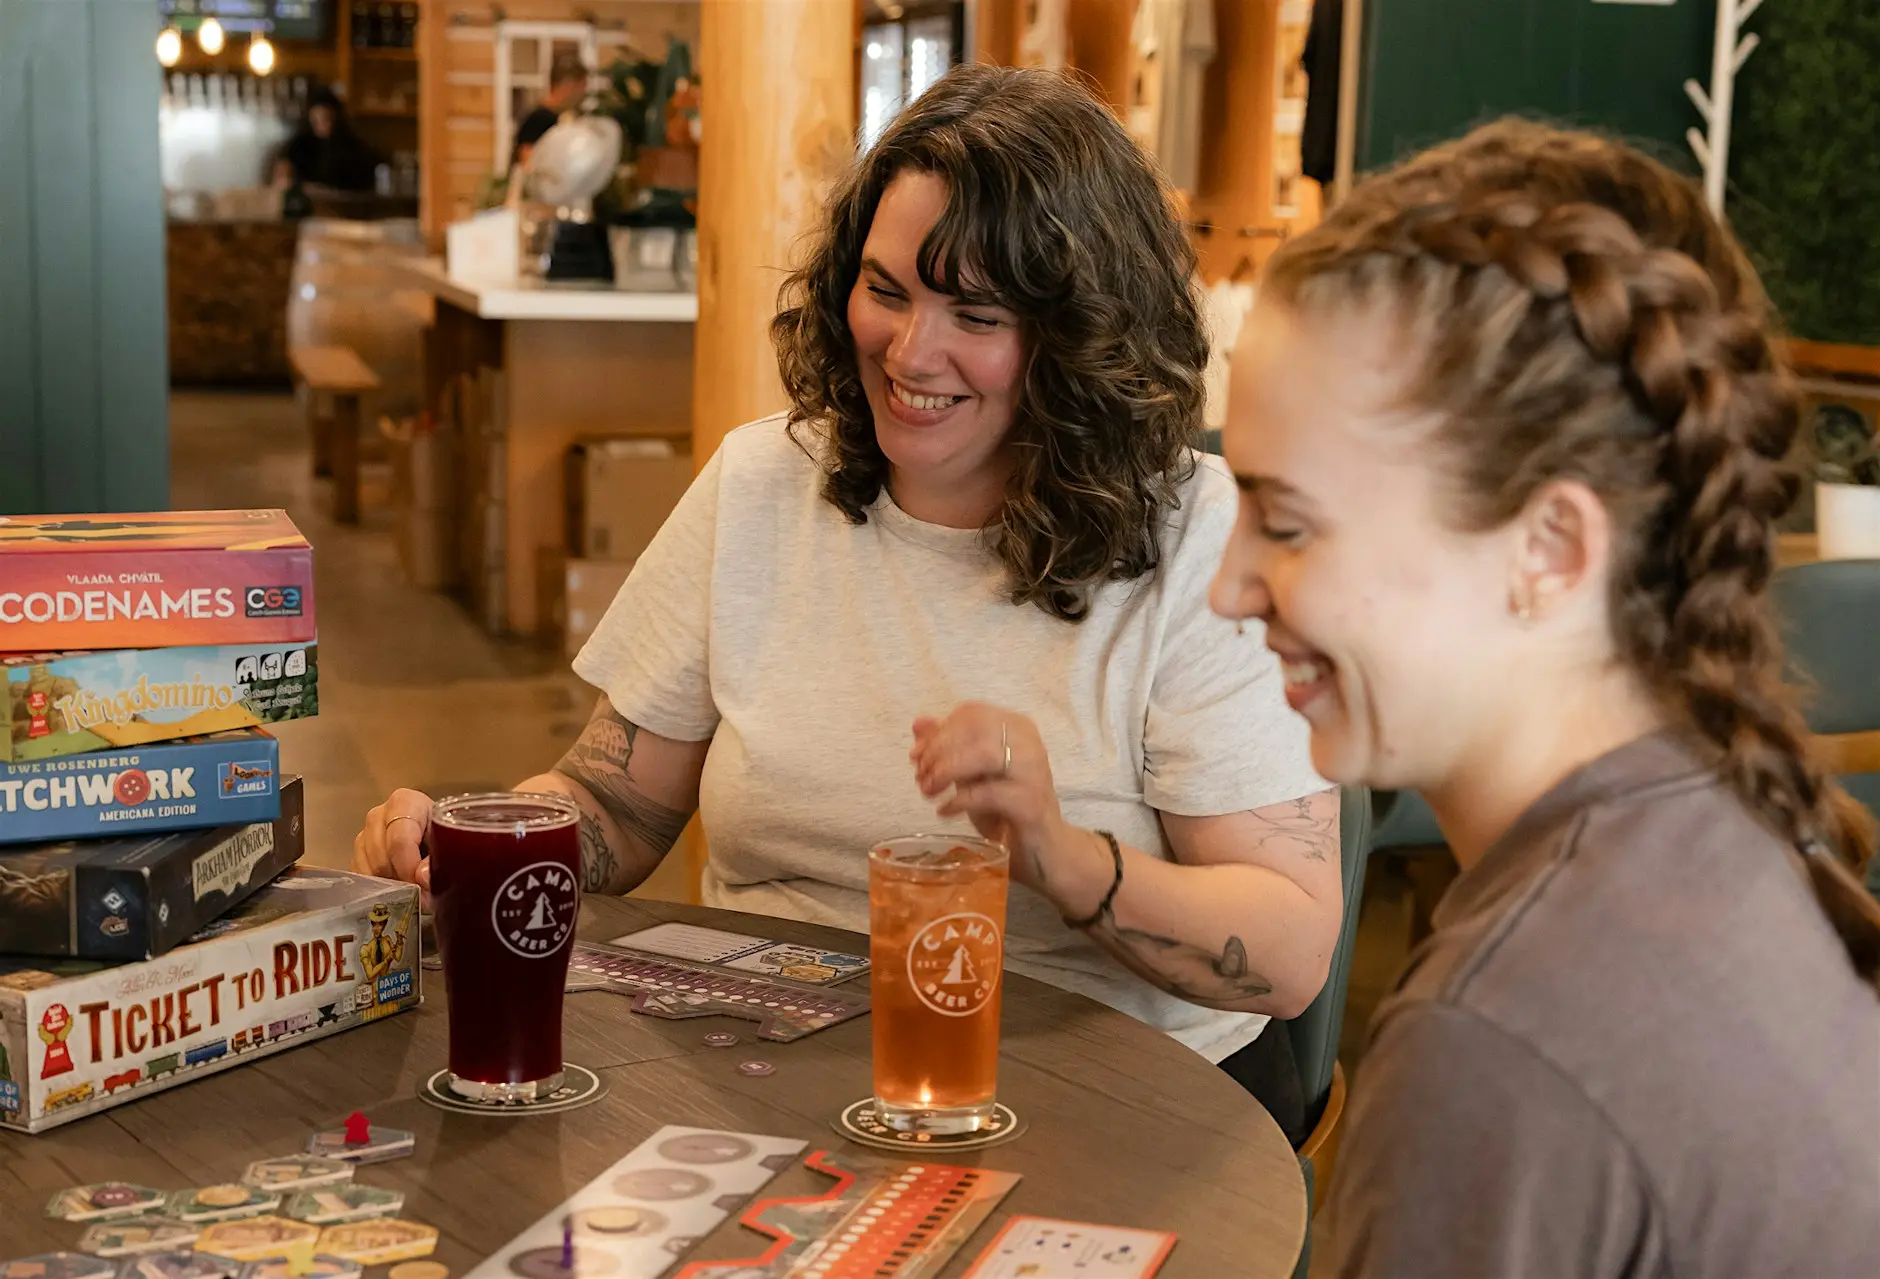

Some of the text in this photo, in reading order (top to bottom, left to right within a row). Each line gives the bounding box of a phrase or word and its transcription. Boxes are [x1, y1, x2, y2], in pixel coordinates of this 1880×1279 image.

[66, 573, 114, 585] VLAADA
[0, 587, 235, 623] CODENAMES
[54, 673, 233, 734] Kingdomino
[8, 755, 140, 775] UWE ROSENBERG
[0, 767, 196, 812] TCHWORK
[237, 780, 267, 793] GAMES
[99, 804, 196, 822] AMERICANA EDITION
[194, 843, 234, 895] ARKHAM
[233, 823, 273, 867] HORROR
[507, 869, 572, 901] CAMP
[509, 929, 548, 950] BEER
[923, 921, 995, 951] CAMP
[379, 972, 410, 989] DAYS OF
[379, 984, 410, 1002] WONDER
[79, 973, 224, 1063] TICKET
[231, 967, 265, 1011] TO
[273, 934, 355, 1000] RIDE
[924, 982, 968, 1008] BEER
